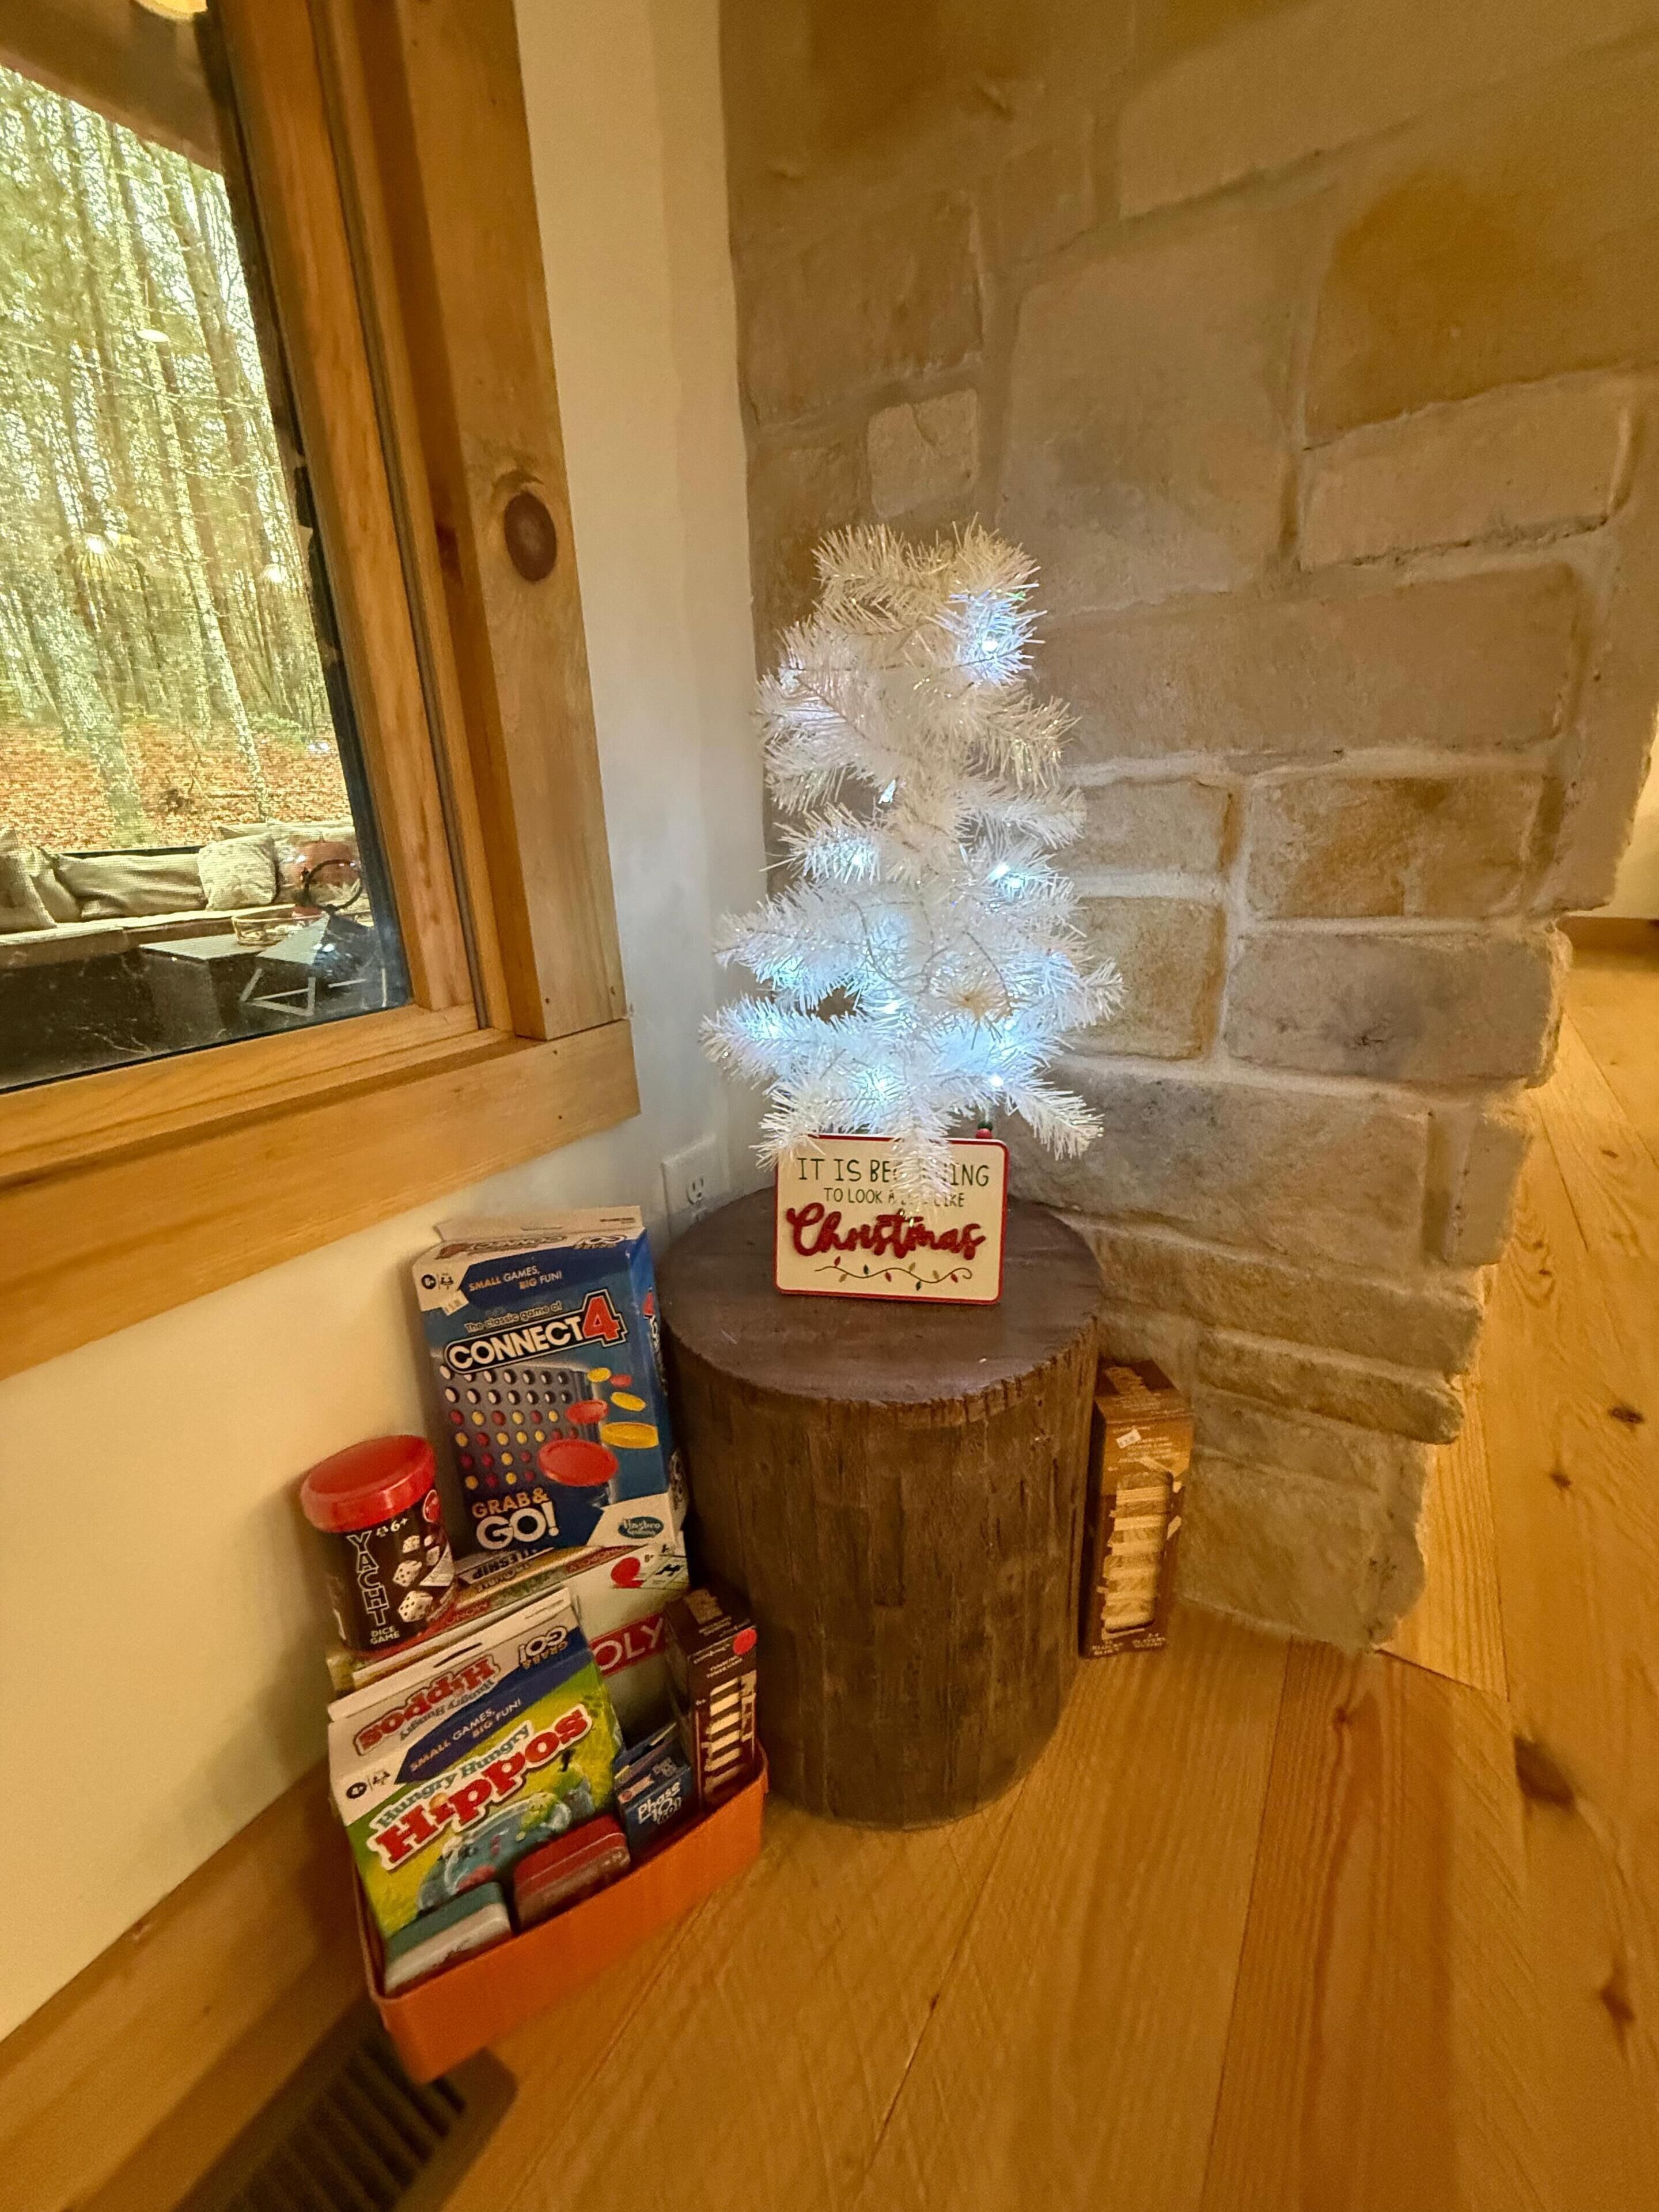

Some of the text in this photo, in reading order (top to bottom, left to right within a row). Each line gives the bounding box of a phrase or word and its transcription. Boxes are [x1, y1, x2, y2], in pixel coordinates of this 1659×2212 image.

[797, 1158, 990, 1187] IT IS BEING
[824, 1187, 843, 1203] TO
[848, 1188, 883, 1205] LOOK
[786, 1202, 986, 1260] Christmas
[468, 1266, 541, 1291] SMALL GAMES,
[519, 1271, 562, 1290] BIG FUN!
[464, 1321, 483, 1334] The
[486, 1312, 519, 1328] classic
[520, 1305, 550, 1323] game
[472, 1487, 551, 1518] GRAB &
[390, 1517, 409, 1532] 6+
[475, 1501, 560, 1550] GO!
[346, 1529, 389, 1627] YACHT
[369, 1631, 400, 1646] GAME
[371, 1626, 396, 1638] DICE
[519, 1625, 568, 1664] GO!
[358, 1657, 495, 1749] Hippos
[472, 1698, 521, 1739] BIG FUN!
[410, 1708, 497, 1772] SMALL GAMES,
[375, 1709, 589, 1863] Hippos
[376, 1724, 532, 1828] Hungry Hungry
[638, 1781, 681, 1824] Phase
